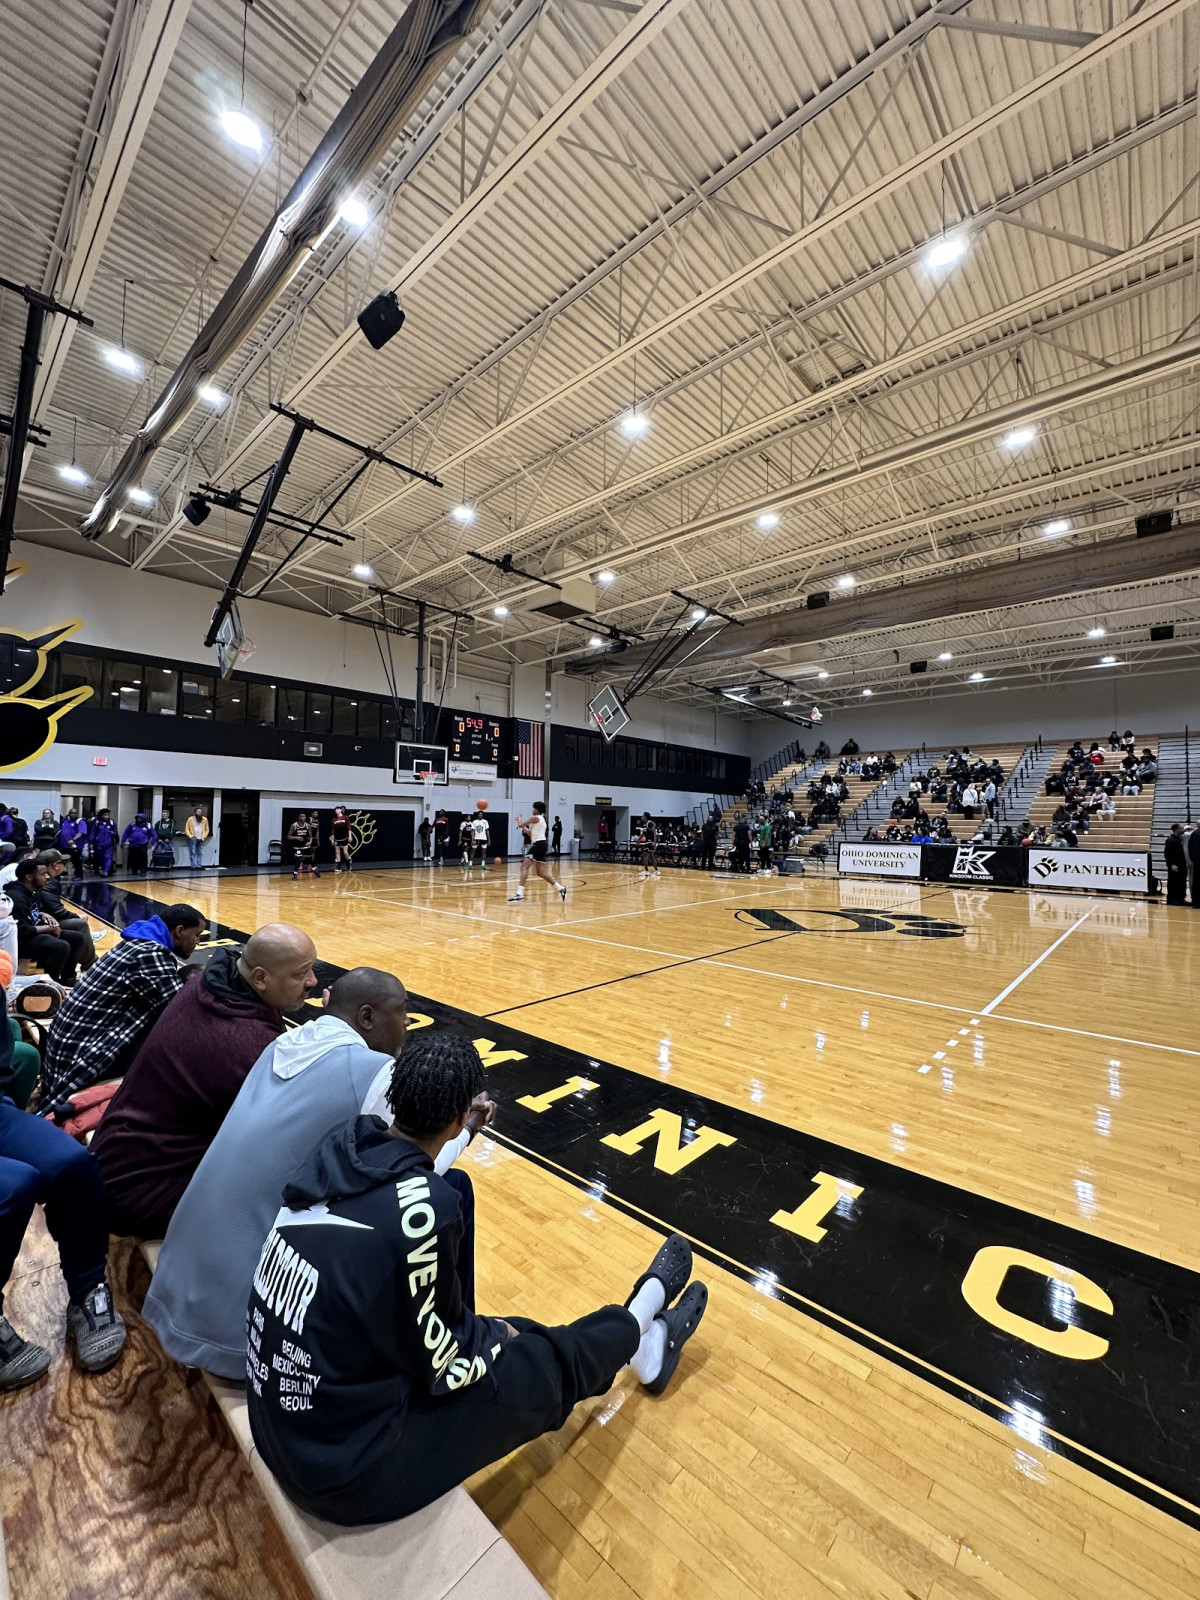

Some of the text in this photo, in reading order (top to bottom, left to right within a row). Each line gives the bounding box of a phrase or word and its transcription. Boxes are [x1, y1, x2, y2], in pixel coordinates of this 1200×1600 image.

[459, 722, 465, 732] 0
[466, 717, 483, 729] 54.9
[494, 727, 500, 738] 0
[841, 849, 919, 860] OHIO DOMINICAN
[852, 859, 906, 868] UNIVERSITY
[1063, 864, 1146, 877] PANTHERS
[253, 1228, 319, 1336] LDTOUR
[282, 1339, 312, 1368] BEIJING
[272, 1353, 321, 1390] MEXICOITY
[279, 1377, 313, 1396] BERLIN
[279, 1396, 313, 1411] SEOUL
